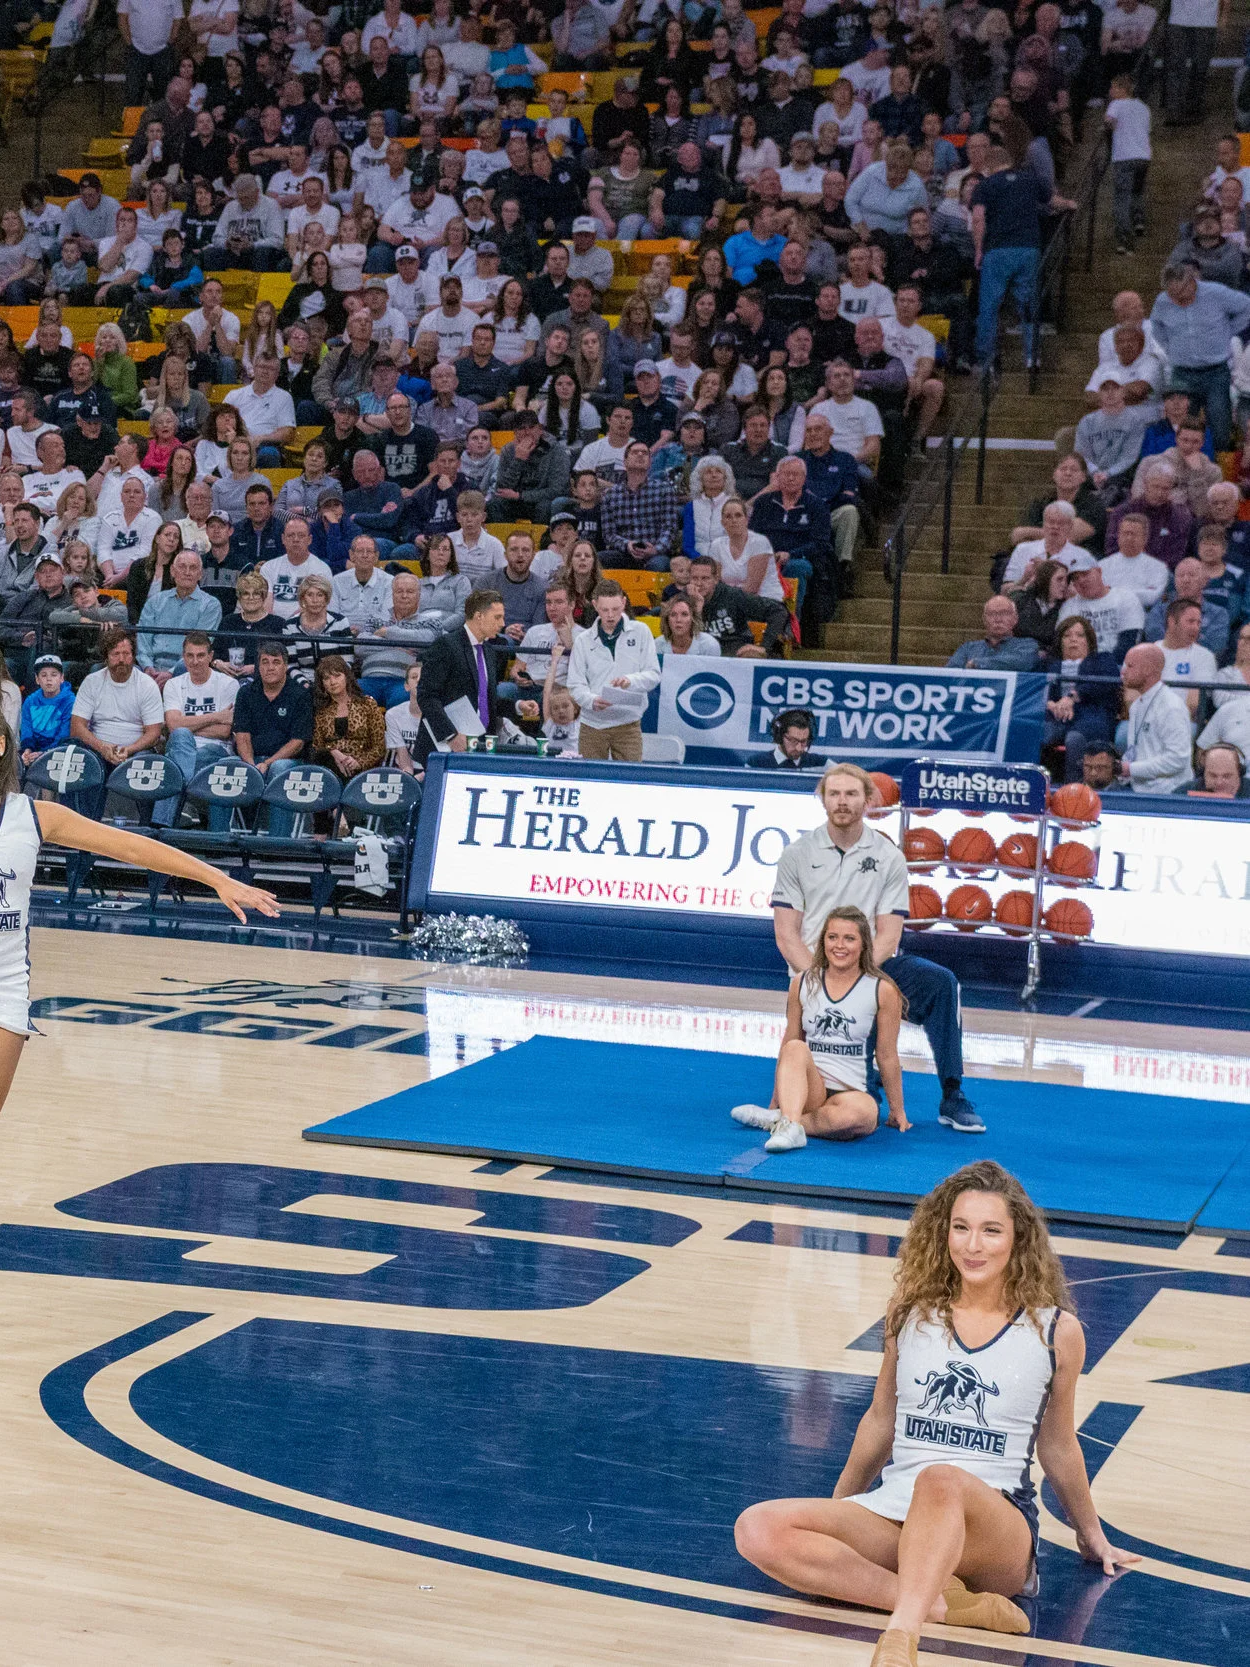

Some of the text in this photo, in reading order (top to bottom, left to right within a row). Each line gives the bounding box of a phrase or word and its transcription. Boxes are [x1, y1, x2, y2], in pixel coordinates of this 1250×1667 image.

[273, 584, 299, 594] STAT
[760, 675, 996, 714] CBS SPORTS
[184, 703, 216, 712] STATE
[758, 706, 954, 742] NTWORK
[126, 768, 165, 781] STATE
[208, 773, 248, 788] STATE
[919, 769, 1031, 795] UtahState
[283, 779, 324, 793] STATE
[361, 781, 403, 794] STATE
[533, 786, 581, 807] THE
[918, 788, 1031, 806] BASKETBALL
[458, 786, 710, 861] HERALD
[529, 874, 688, 905] EMPOWERING
[695, 886, 743, 909] THE
[809, 1041, 864, 1056] UTAH STATE
[904, 1414, 1008, 1457] UTAH STATE
